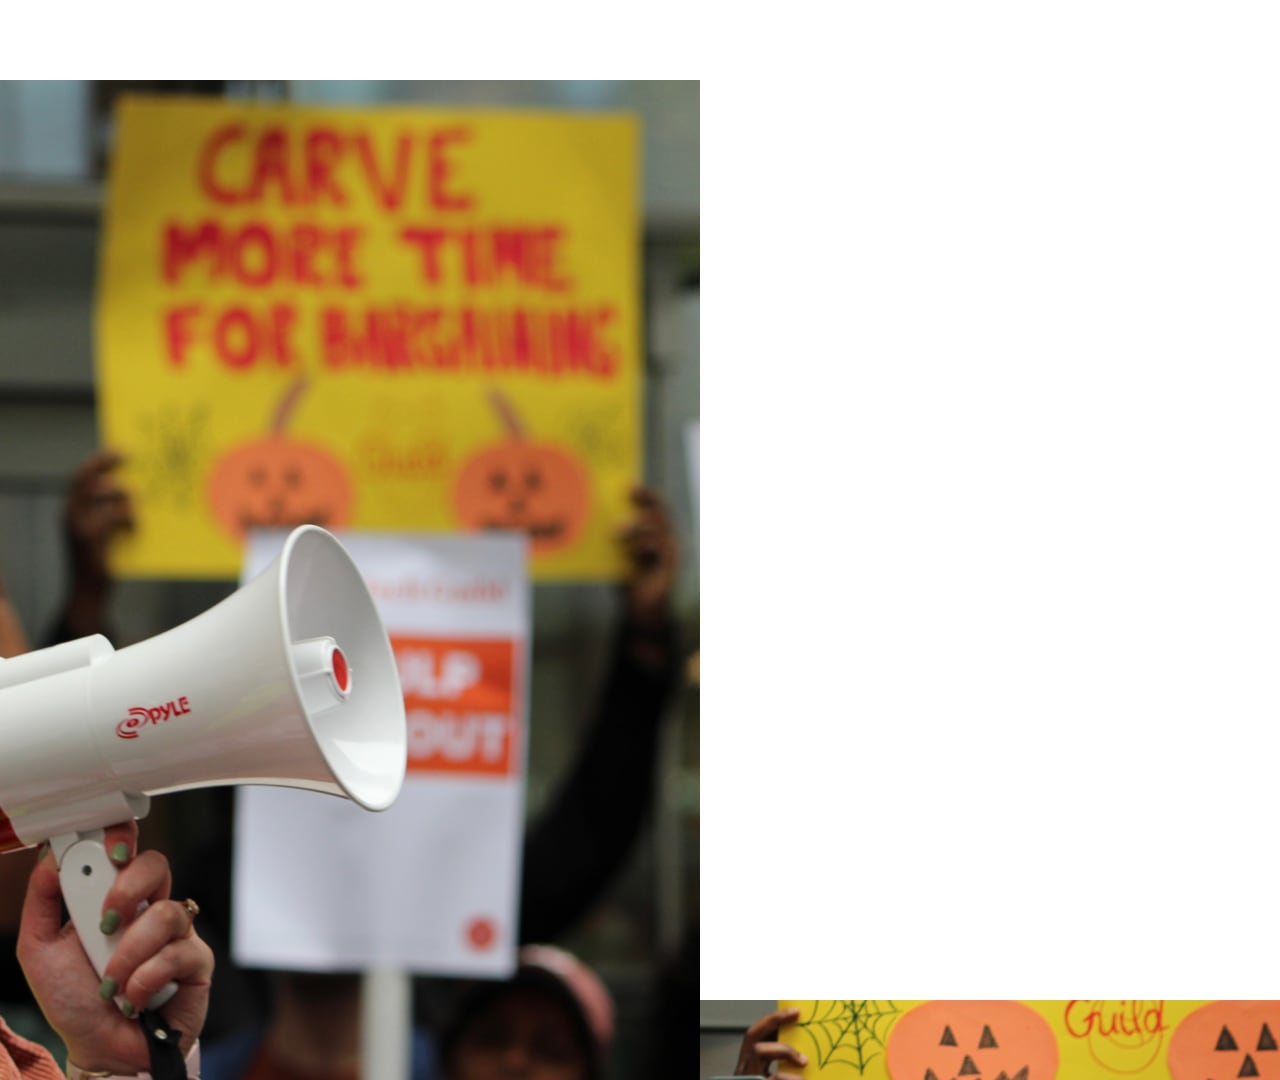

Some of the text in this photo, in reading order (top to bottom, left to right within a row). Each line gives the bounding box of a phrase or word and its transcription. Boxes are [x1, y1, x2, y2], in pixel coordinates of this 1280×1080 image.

[198, 122, 478, 214] CARVE
[162, 217, 574, 293] MORE TIME
[163, 303, 618, 378] FOR BARGAINING
[1065, 1000, 1169, 1038] Guild
